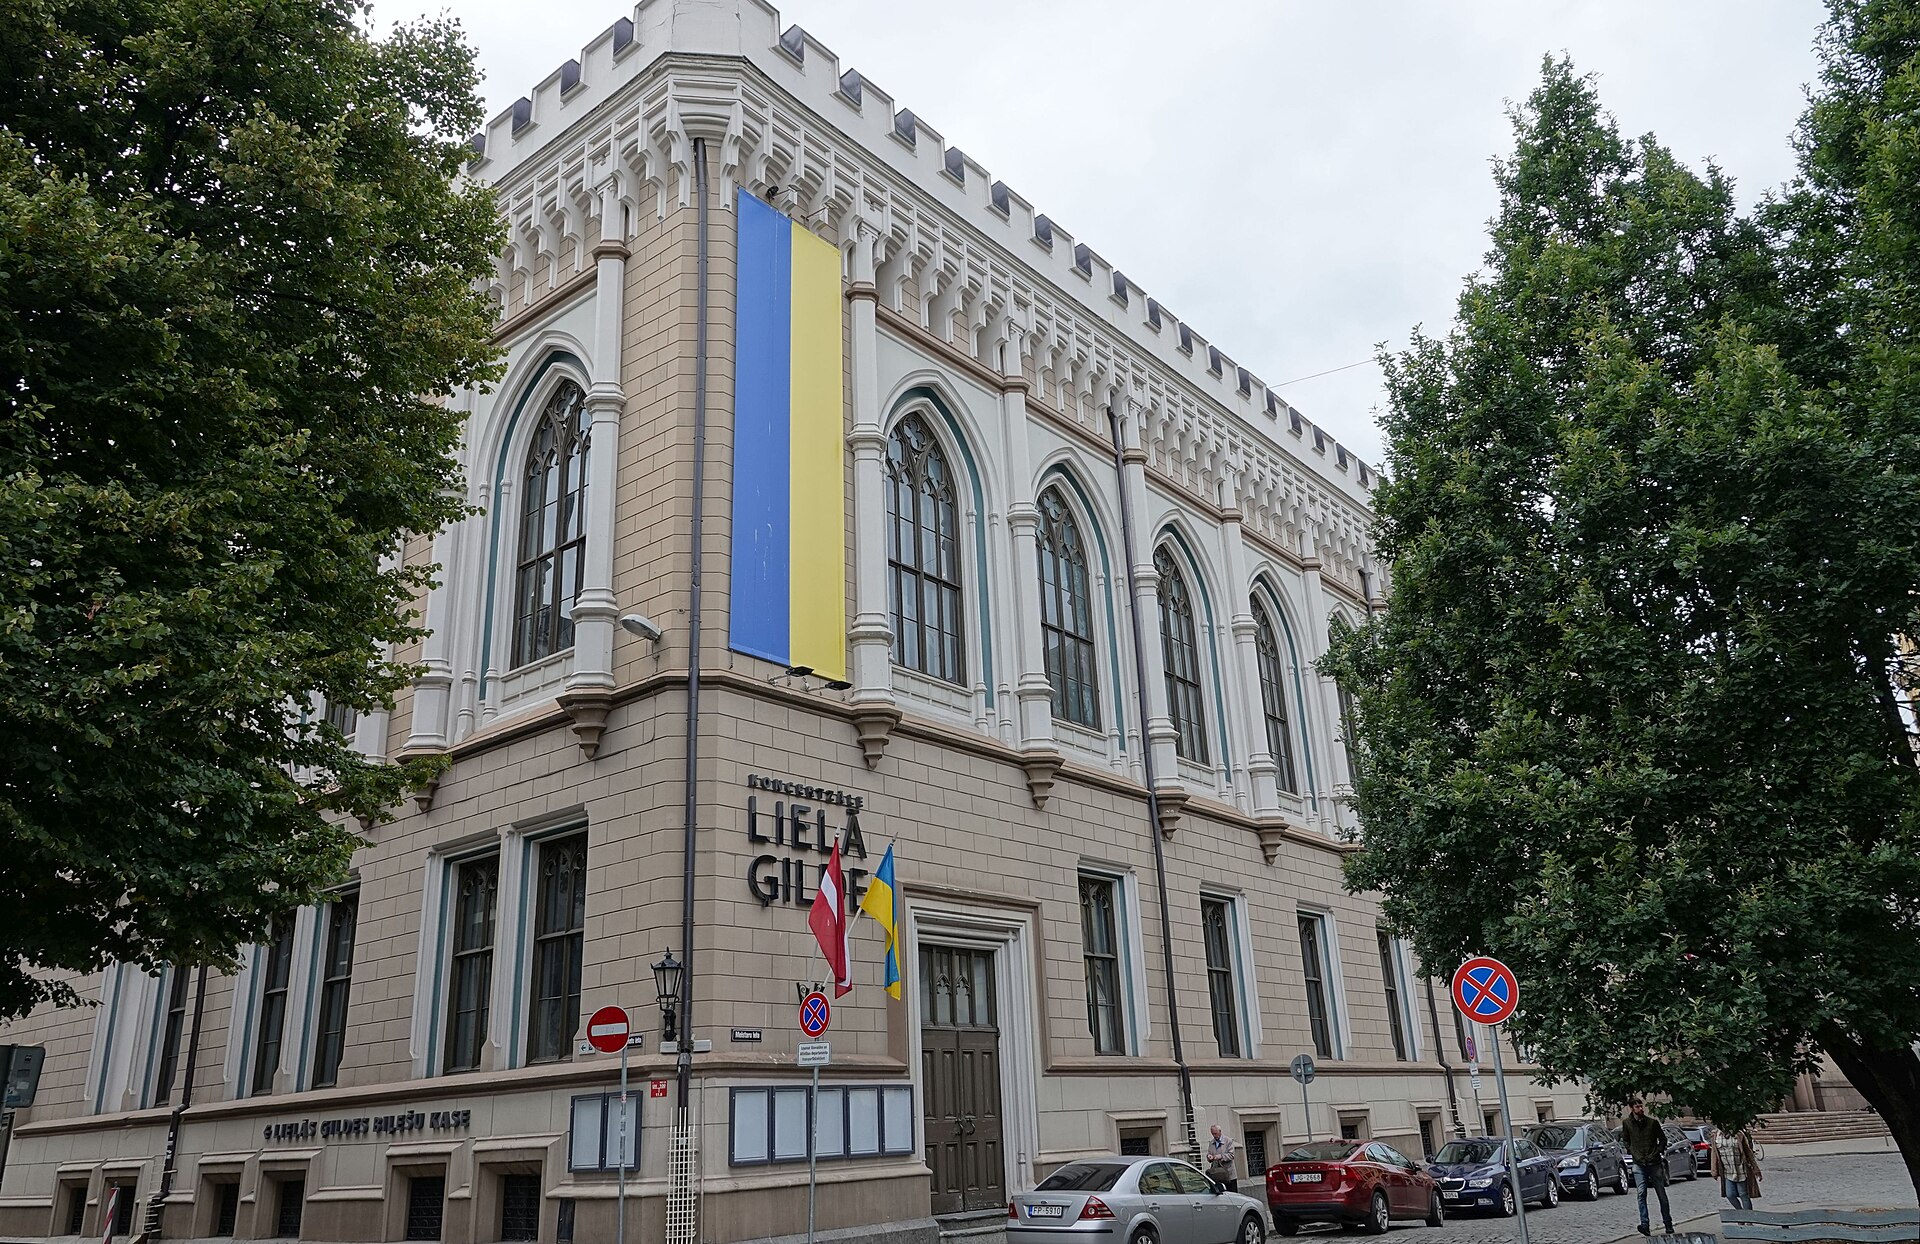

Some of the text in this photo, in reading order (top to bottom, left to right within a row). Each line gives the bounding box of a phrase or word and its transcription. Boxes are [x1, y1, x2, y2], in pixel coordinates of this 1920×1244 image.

[747, 795, 868, 859] LIELĀ
[273, 1119, 318, 1139] LIELĀS
[429, 1109, 471, 1129] KASE
[1033, 1206, 1061, 1215] FP-5910
